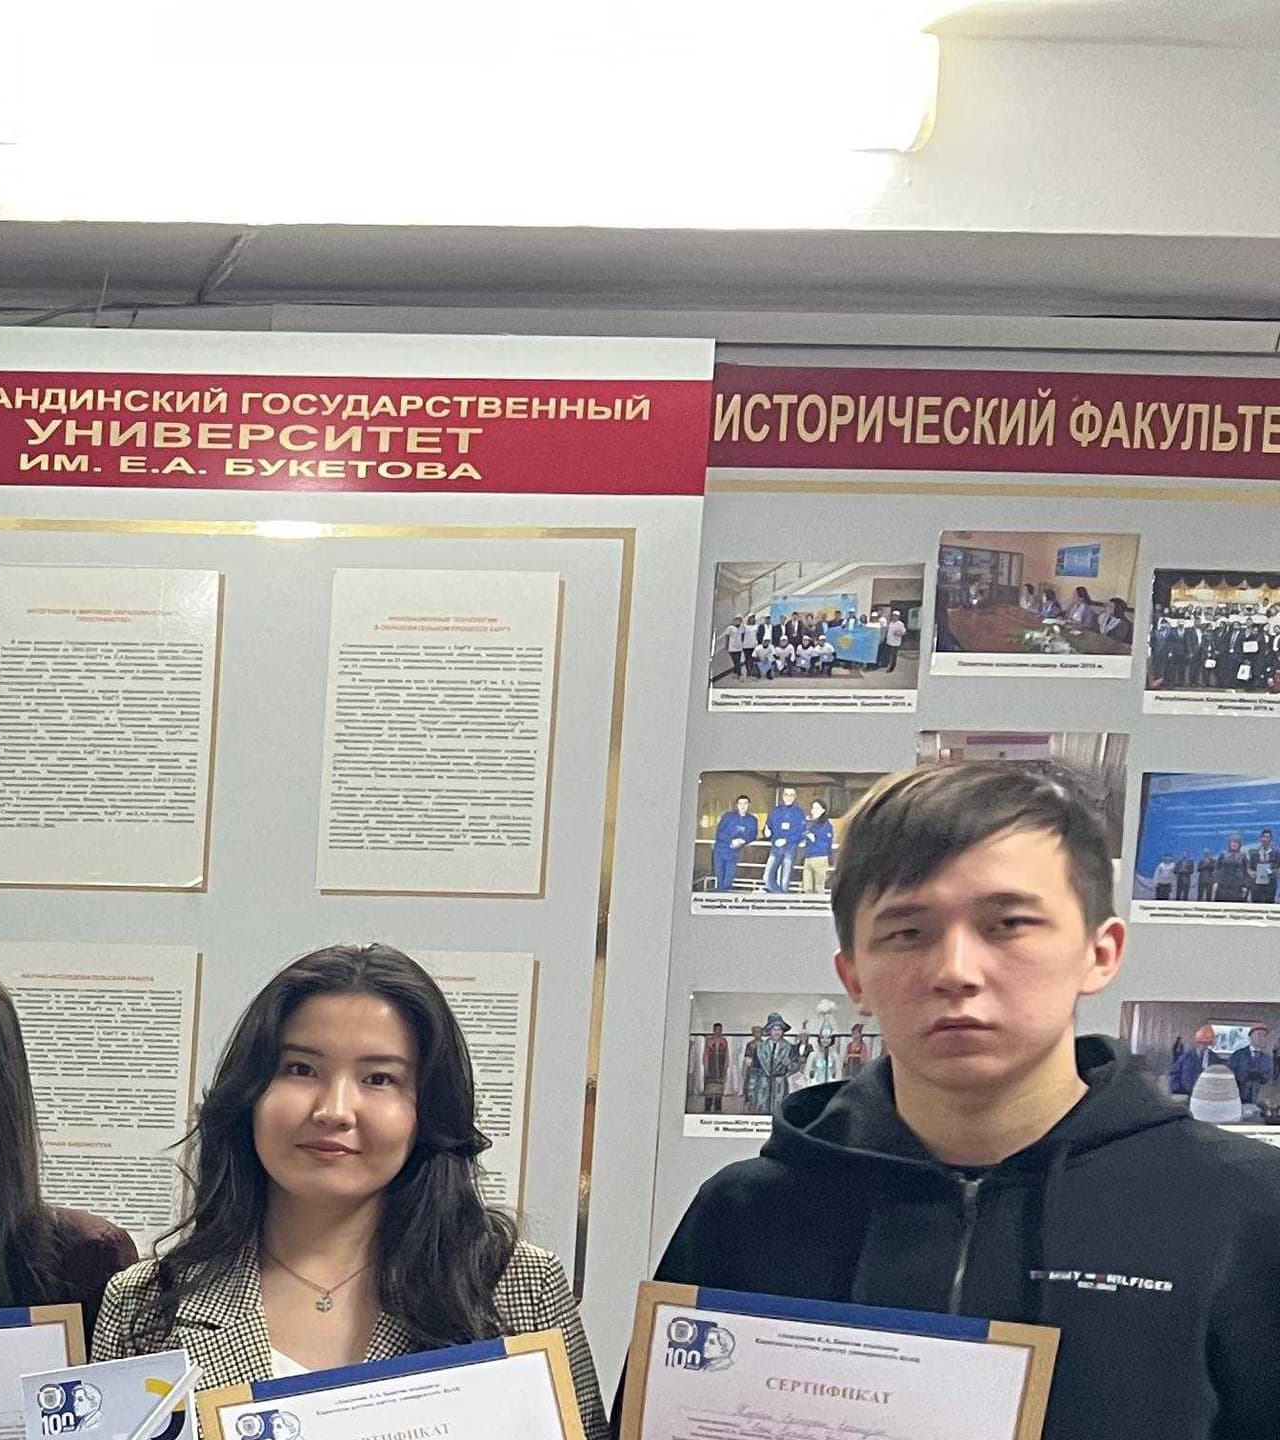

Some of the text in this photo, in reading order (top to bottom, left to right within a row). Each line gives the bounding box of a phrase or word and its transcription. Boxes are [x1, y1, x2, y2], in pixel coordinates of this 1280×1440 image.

[240, 390, 651, 422] ГОСУДАРСТВЕННЫЙ
[713, 387, 1057, 447] ИСТОРИЧЕСКИЙ
[25, 418, 482, 455] УНИВЕРСИТЕТ
[18, 453, 483, 481] ИМ. Е.А. БУКЕТОВА
[765, 1376, 893, 1404] СЕРТИФИКАТ
